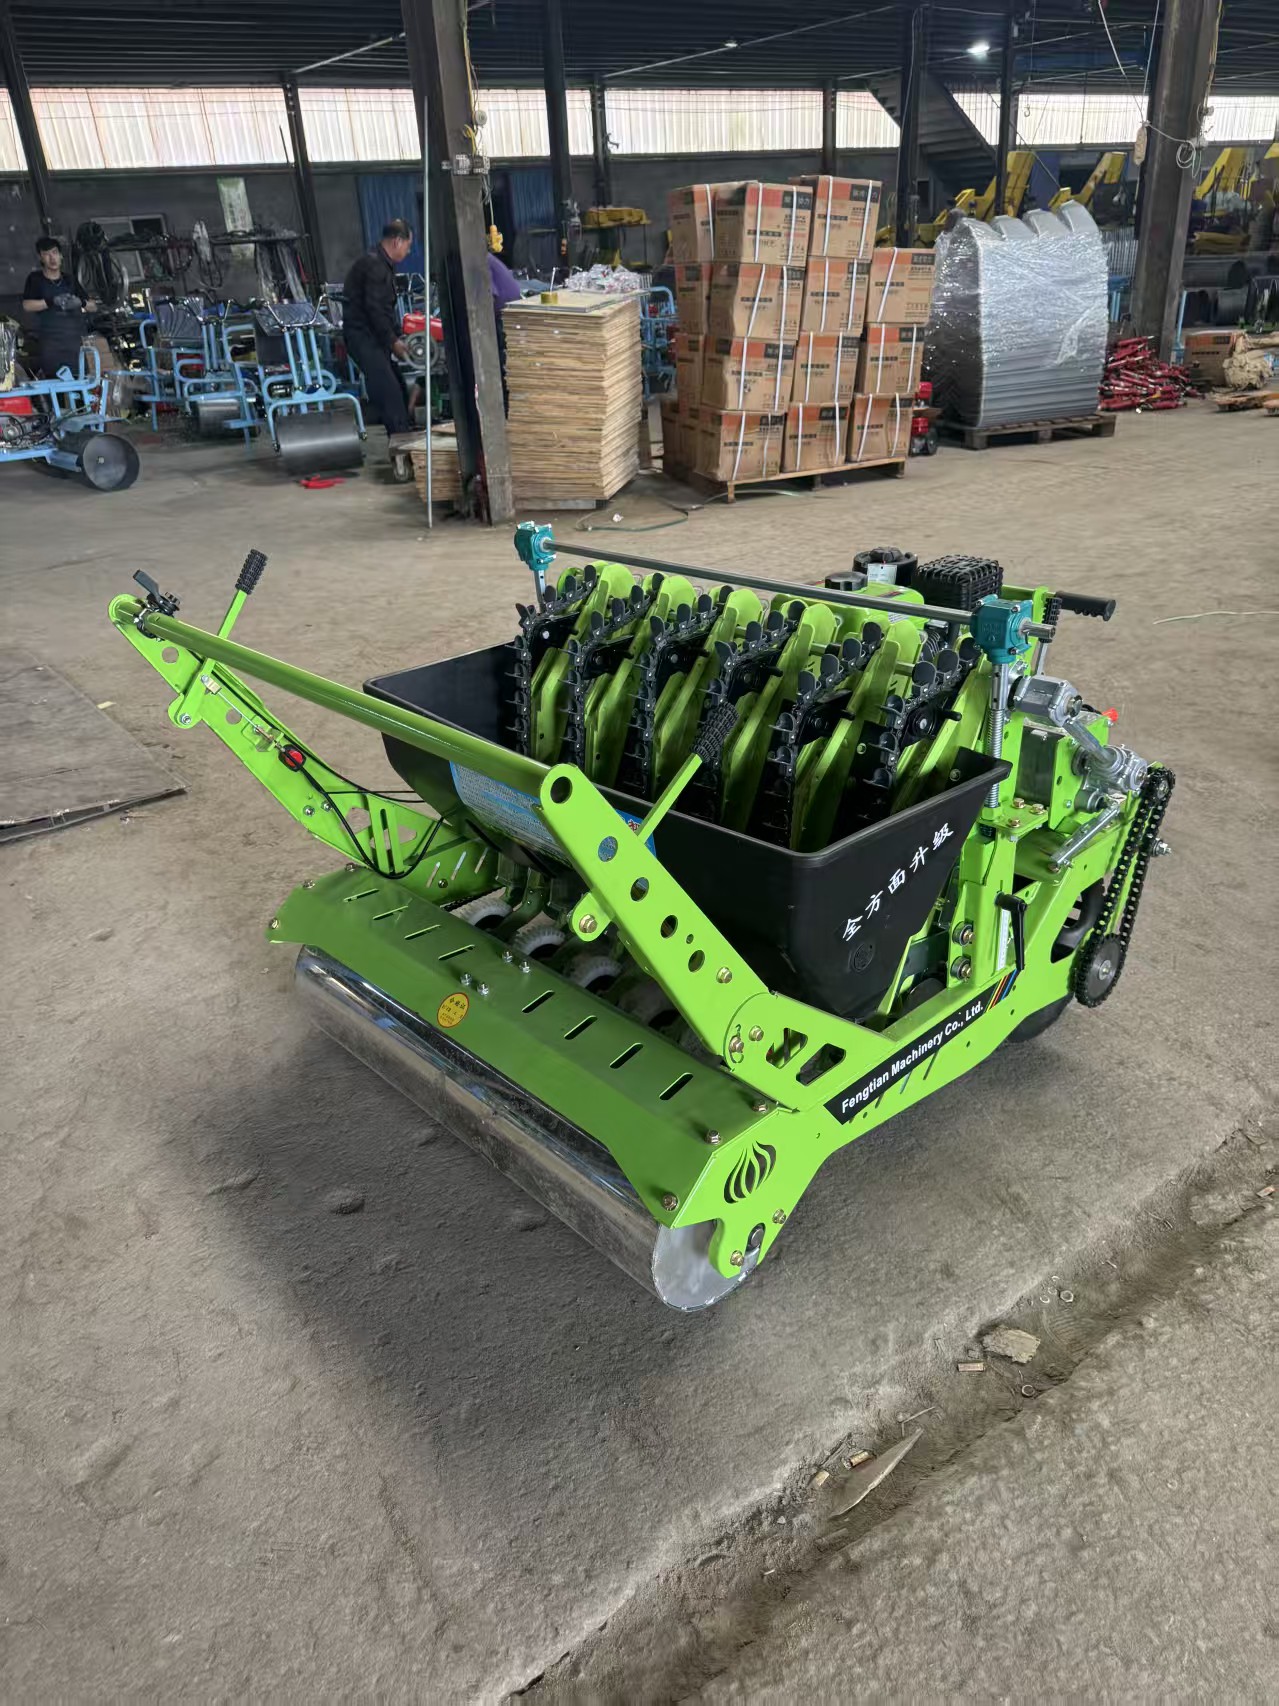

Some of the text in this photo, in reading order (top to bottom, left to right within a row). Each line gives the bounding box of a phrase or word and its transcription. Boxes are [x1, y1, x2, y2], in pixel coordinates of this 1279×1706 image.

[842, 822, 954, 942] 全方面升级
[842, 1001, 983, 1114] Fengtian Machinery Co., Ltd.
